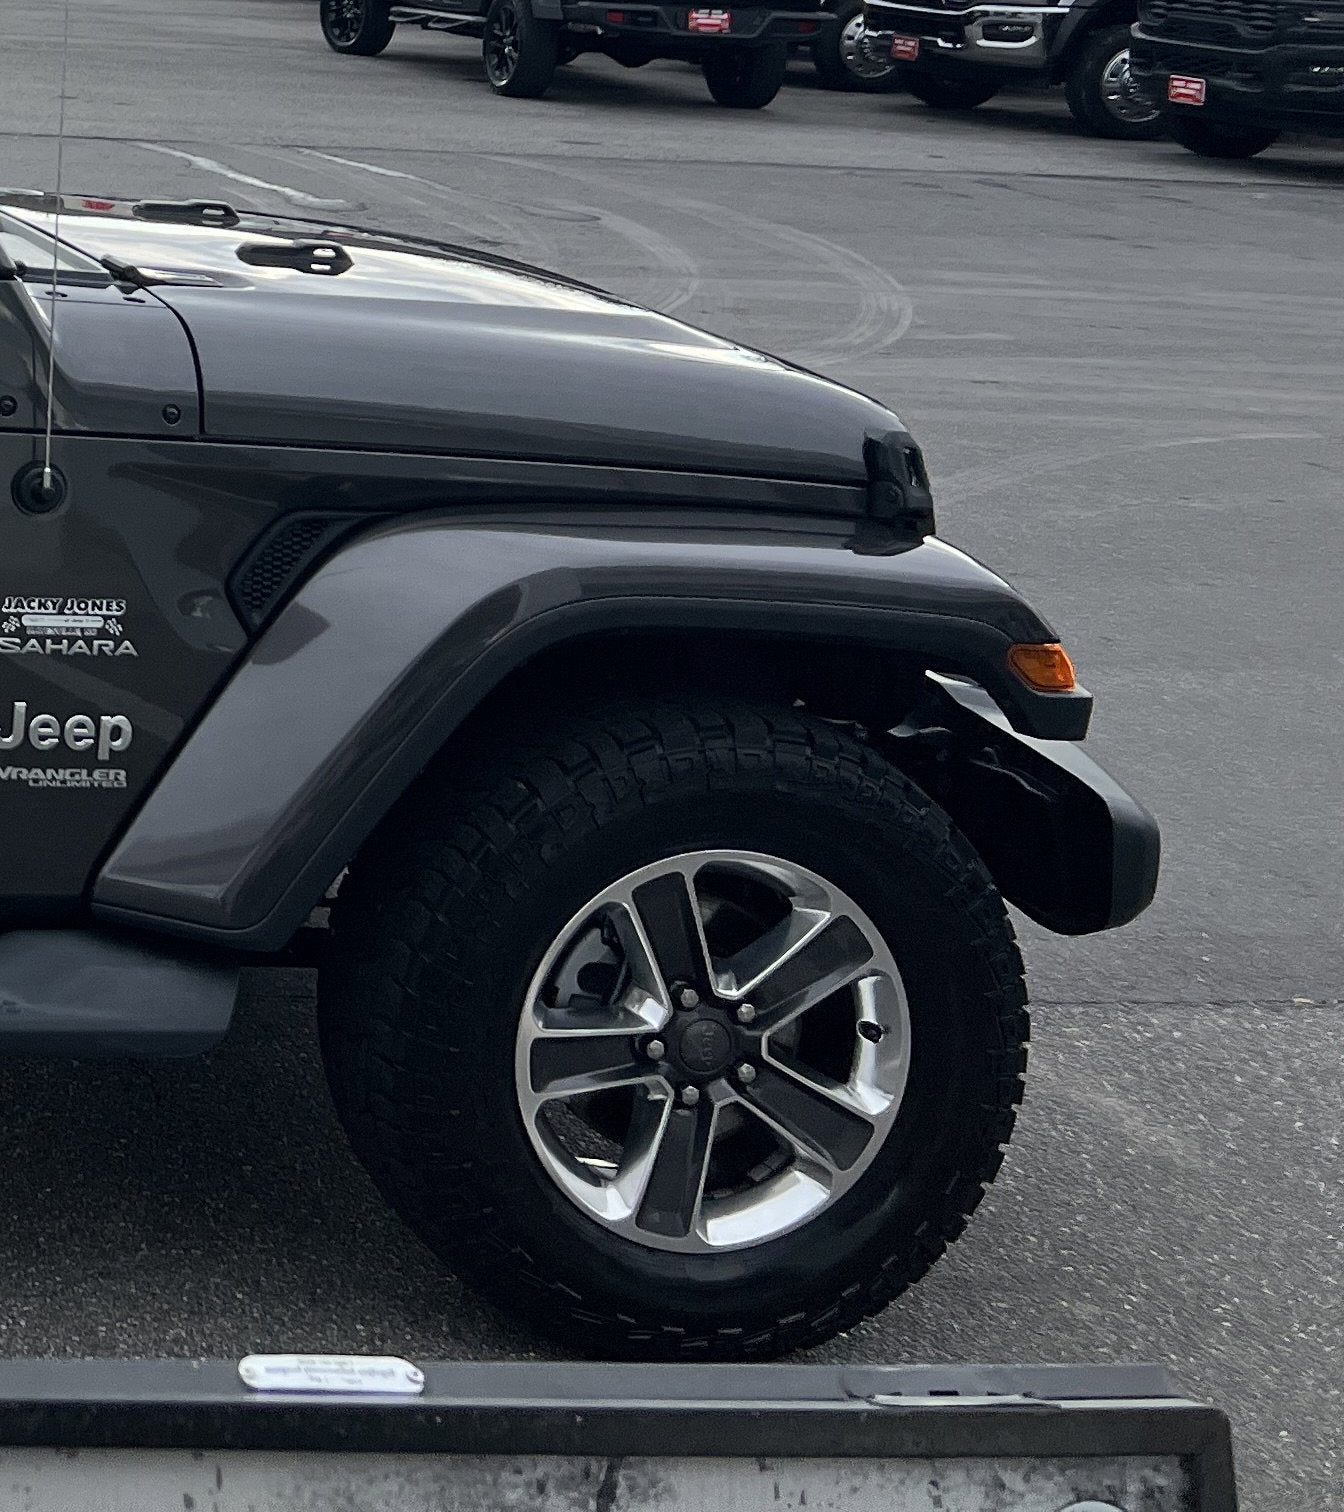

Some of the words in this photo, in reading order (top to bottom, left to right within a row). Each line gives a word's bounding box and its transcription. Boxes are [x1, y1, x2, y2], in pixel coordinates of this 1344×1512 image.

[1, 596, 62, 614] JACKY
[64, 597, 127, 616] JONES
[28, 778, 127, 788] UNLIMITED
